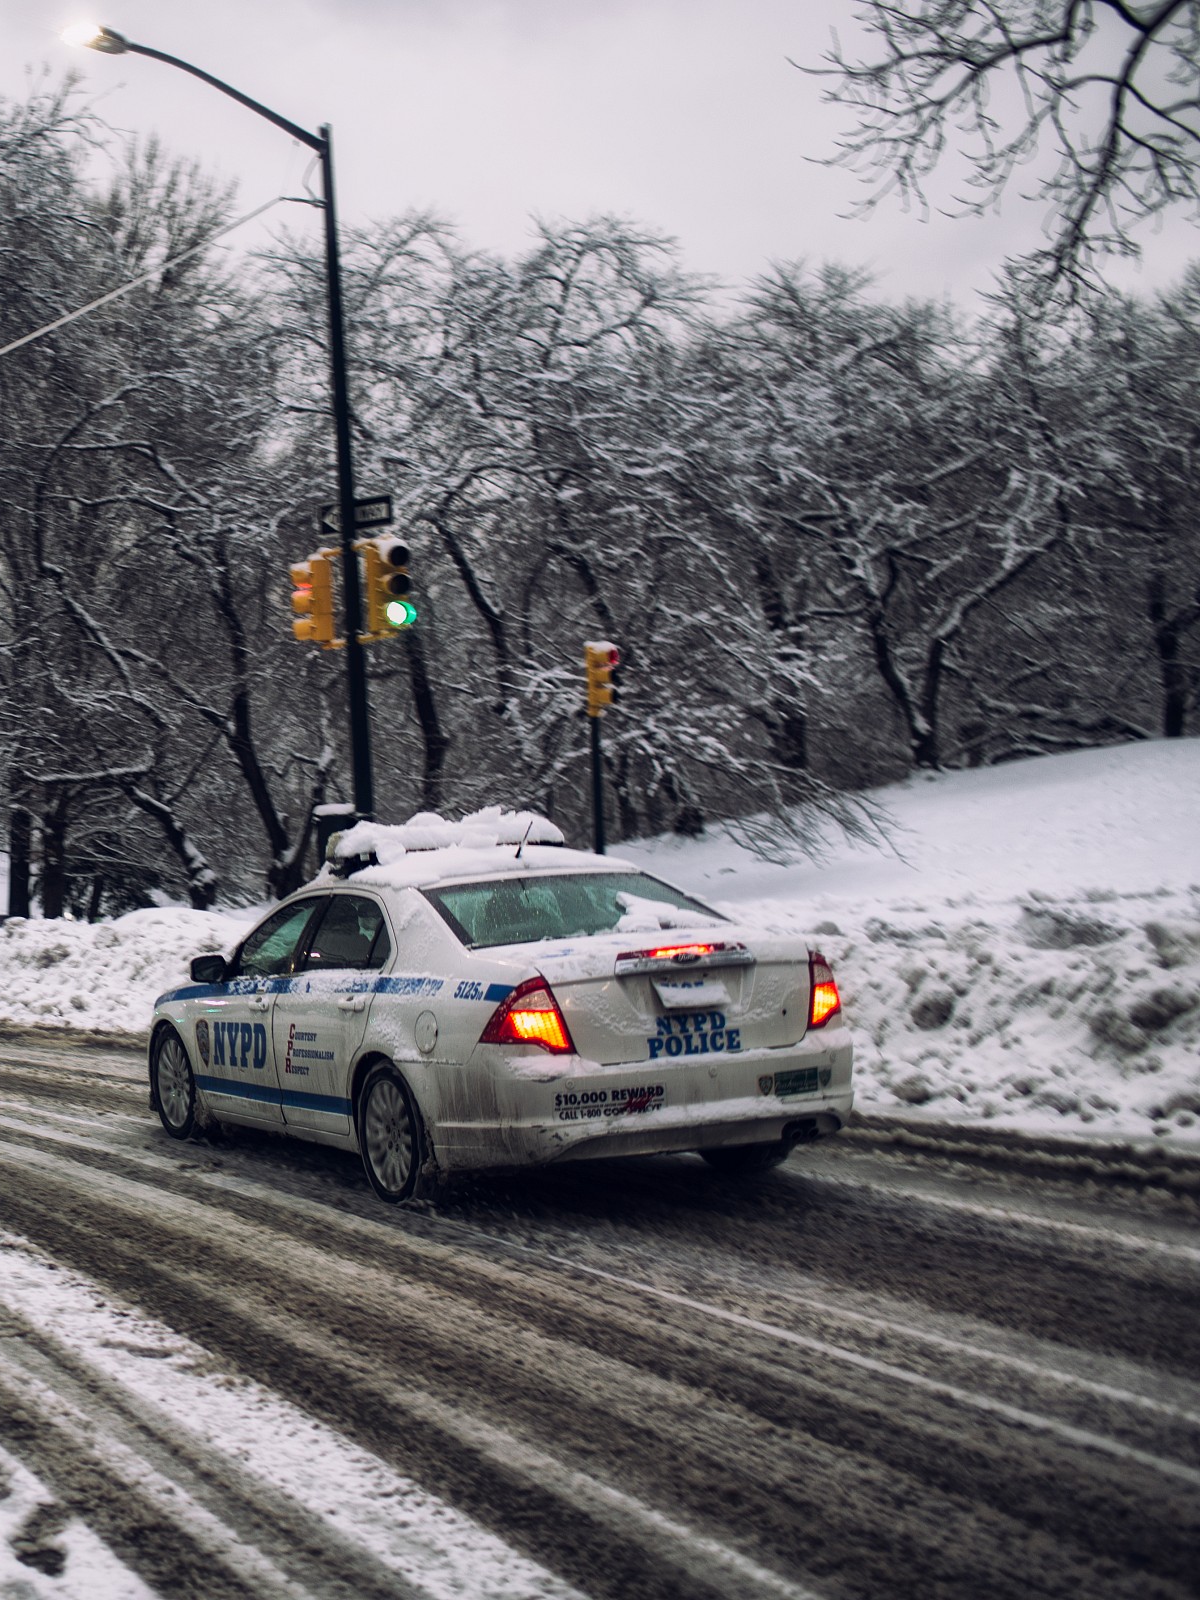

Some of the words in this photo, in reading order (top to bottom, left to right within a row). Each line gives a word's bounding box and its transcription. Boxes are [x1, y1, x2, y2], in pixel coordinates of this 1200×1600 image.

[454, 980, 482, 999] 5125
[289, 1023, 318, 1042] COURTESY
[656, 1010, 726, 1036] NYPD
[213, 1021, 267, 1069] NYPD
[287, 1040, 335, 1060] PROFESSIONALISM
[647, 1029, 741, 1059] POLICE
[285, 1058, 309, 1076] RESPECT
[554, 1090, 607, 1107] $10,000
[611, 1085, 664, 1102] REWARD
[559, 1110, 578, 1121] CALL
[580, 1108, 602, 1120] 1-800
